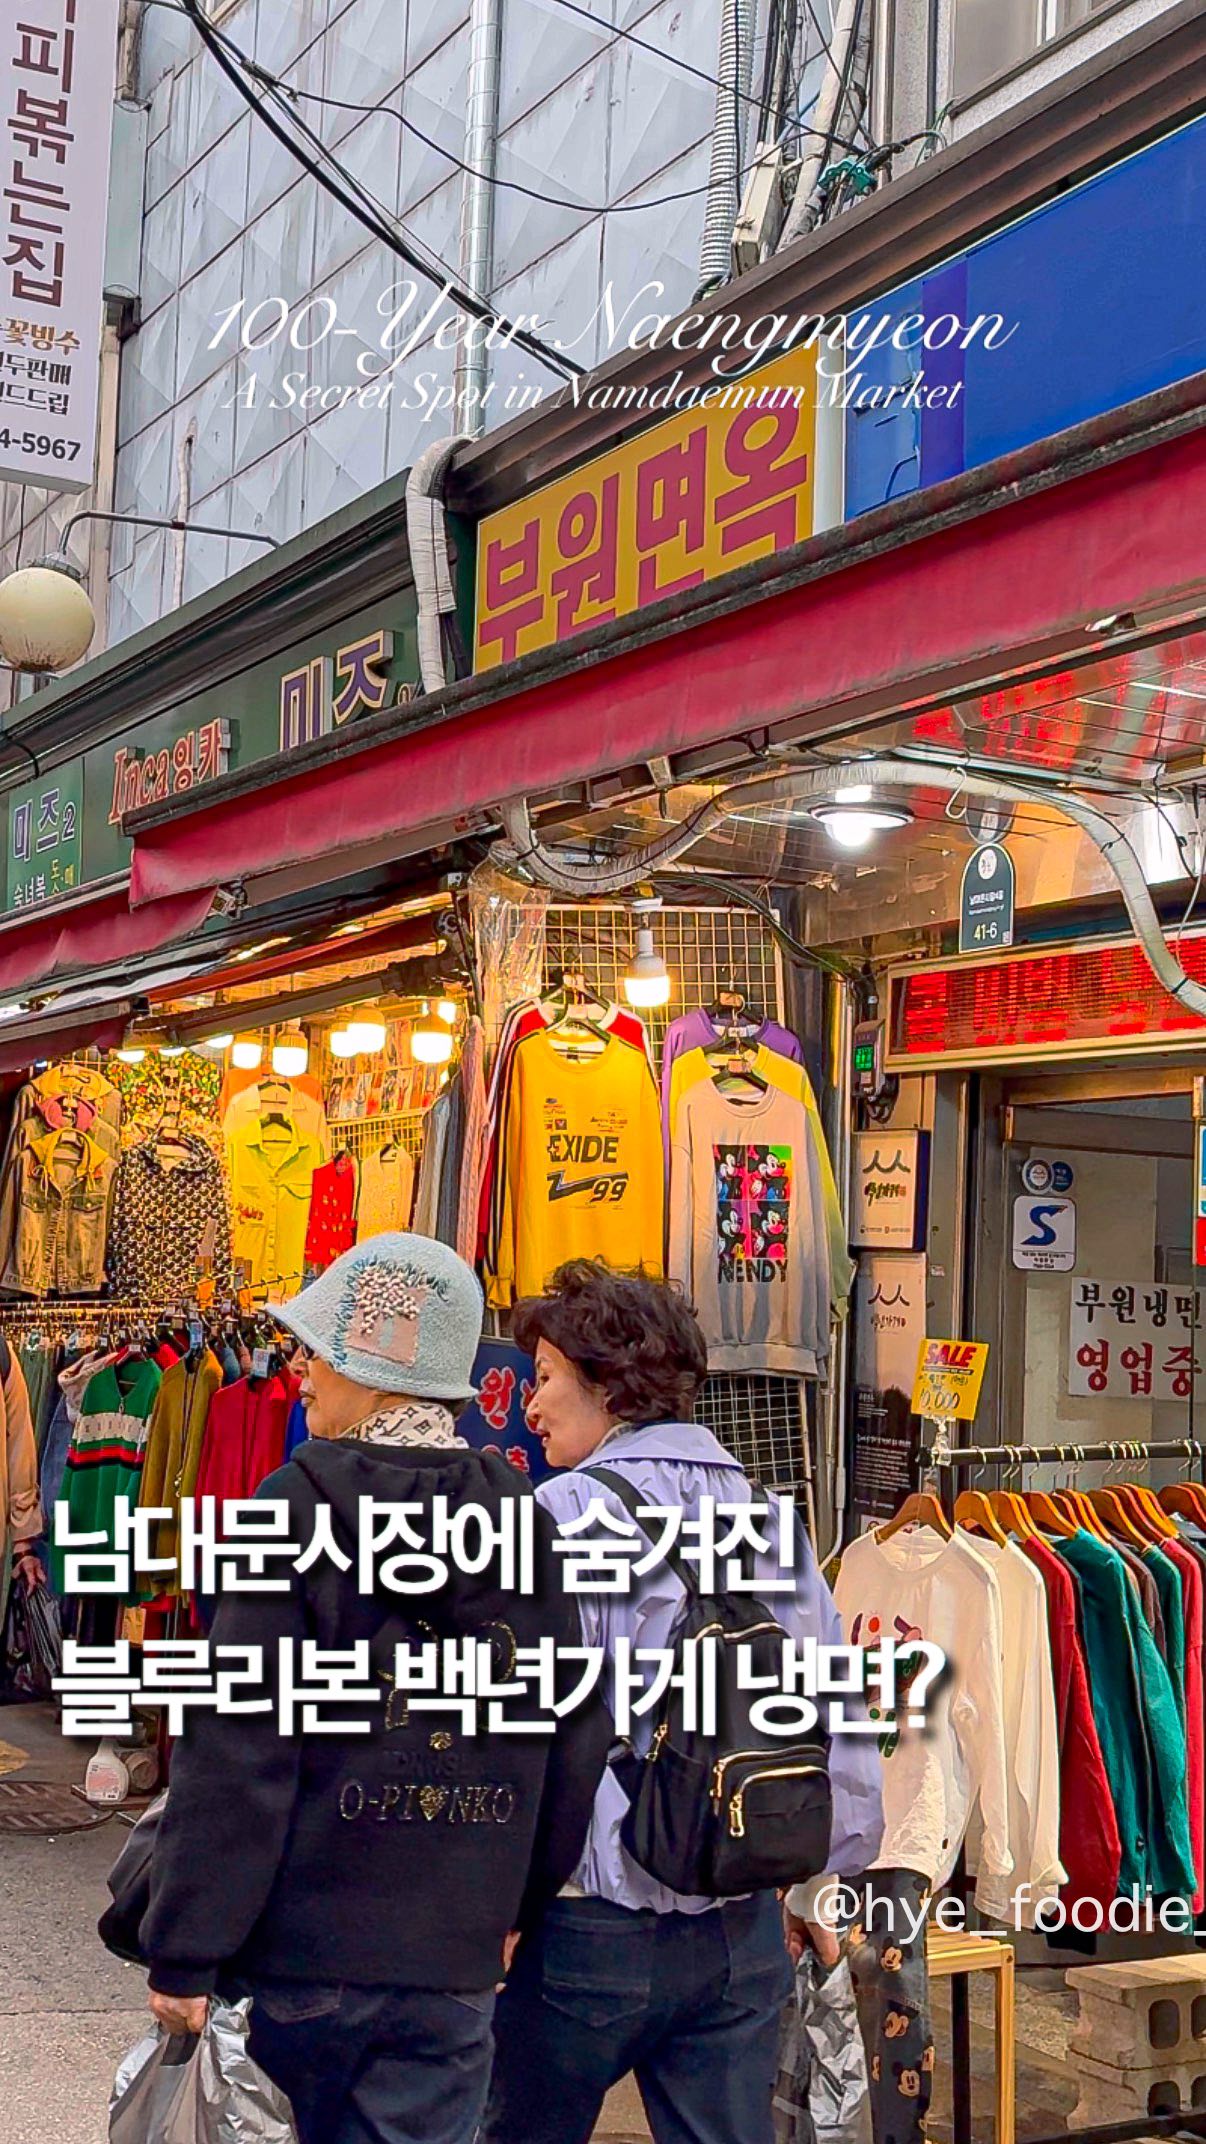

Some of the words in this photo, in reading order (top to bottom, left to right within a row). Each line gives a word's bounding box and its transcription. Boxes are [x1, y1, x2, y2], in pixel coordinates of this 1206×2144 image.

[0, 317, 81, 356] 꽃빙수
[479, 388, 808, 662] 부원면옥
[974, 921, 998, 940] 41-6
[546, 1135, 619, 1163] EXIDE
[1075, 1283, 1203, 1329] 부원냉면
[925, 1343, 978, 1367] SALE
[1077, 1339, 1204, 1397] 영업중
